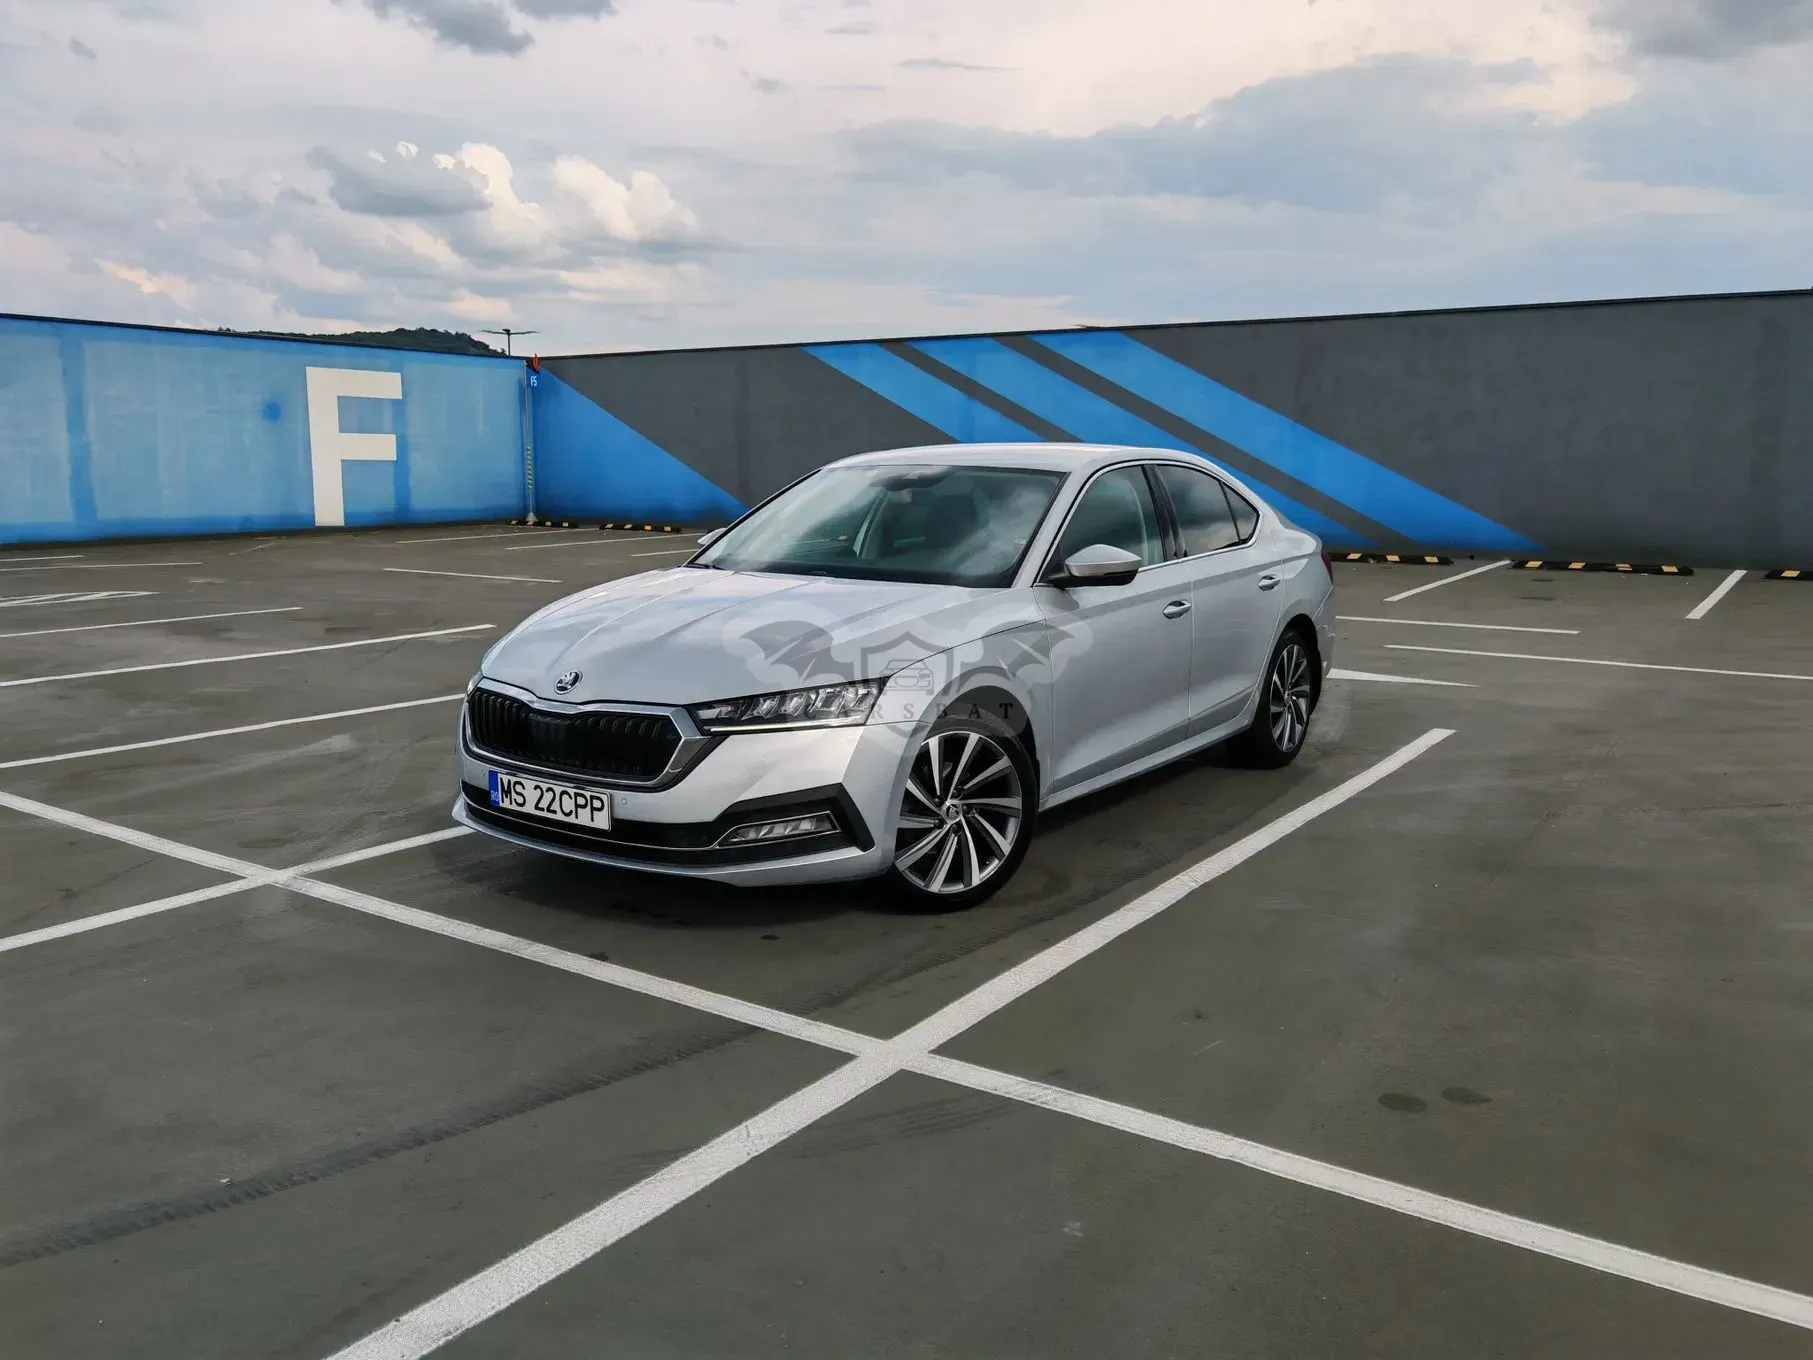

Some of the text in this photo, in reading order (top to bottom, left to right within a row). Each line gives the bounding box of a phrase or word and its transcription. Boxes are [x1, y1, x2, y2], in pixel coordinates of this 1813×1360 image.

[306, 366, 402, 526] F
[500, 777, 605, 823] MS 22CPP
